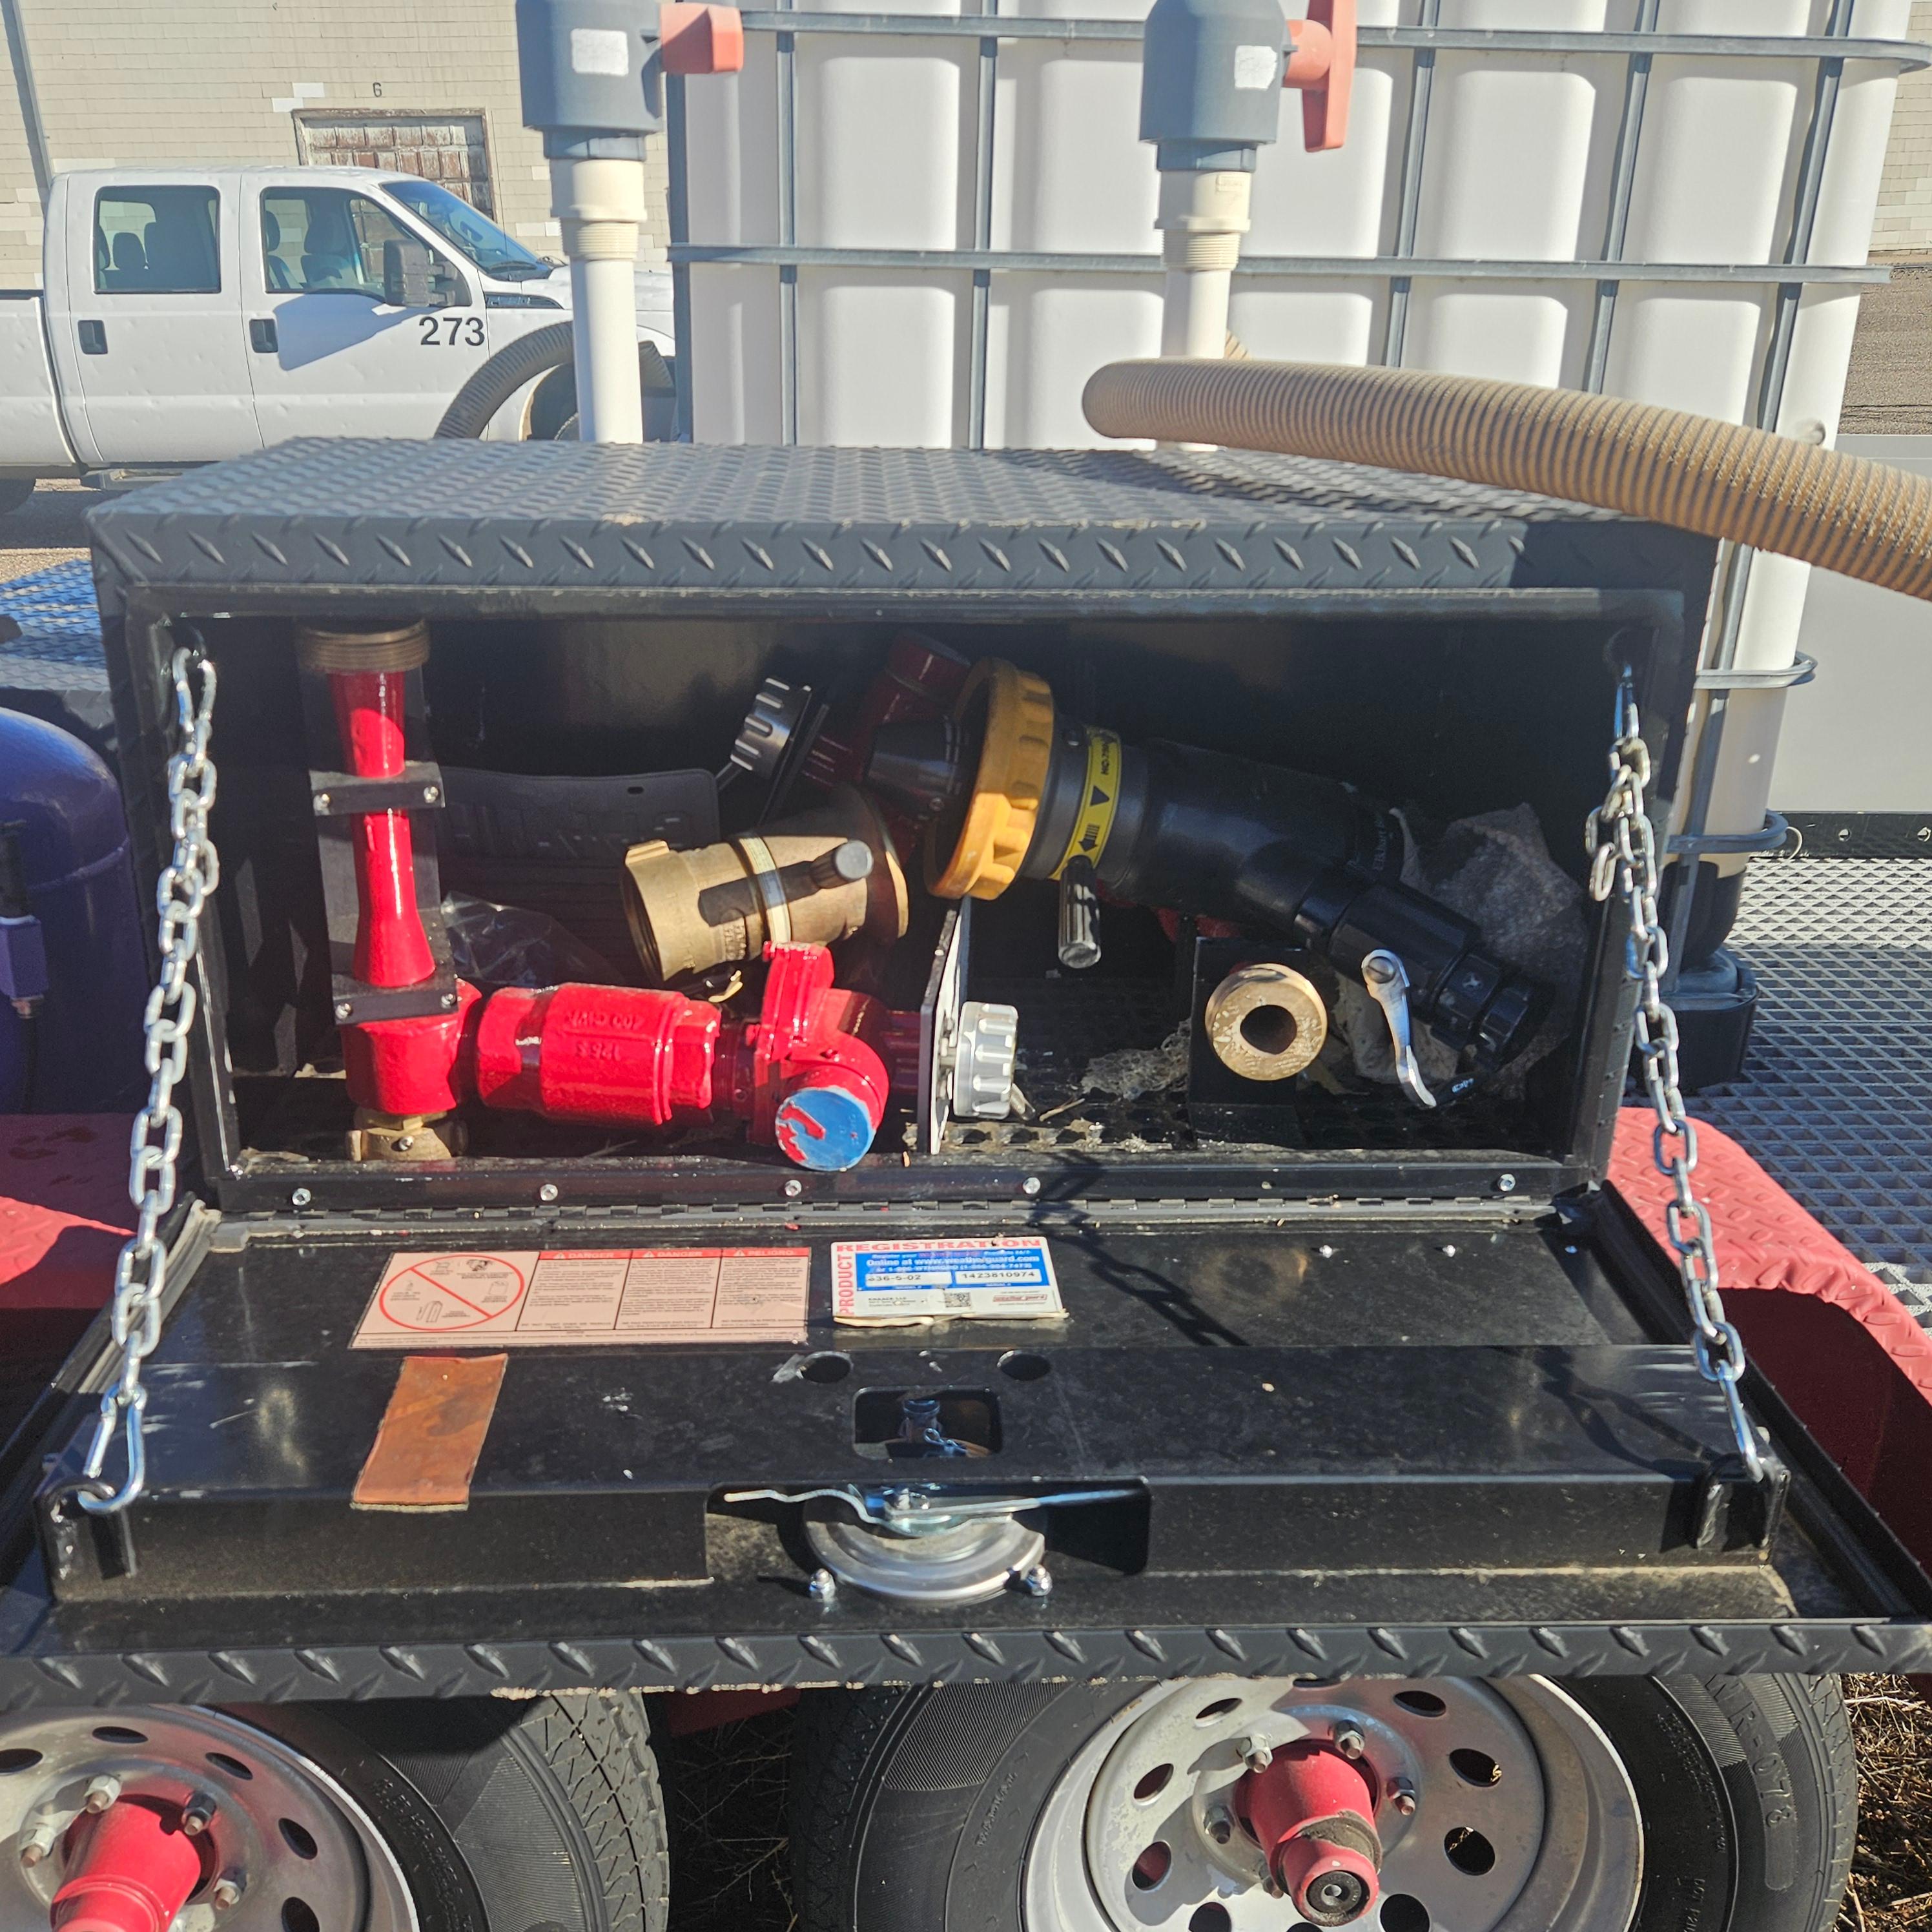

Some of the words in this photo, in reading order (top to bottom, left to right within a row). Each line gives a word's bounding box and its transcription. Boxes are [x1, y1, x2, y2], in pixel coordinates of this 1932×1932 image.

[373, 82, 383, 98] 6
[419, 316, 485, 346] 273
[838, 1255, 854, 1315] PRODUCT
